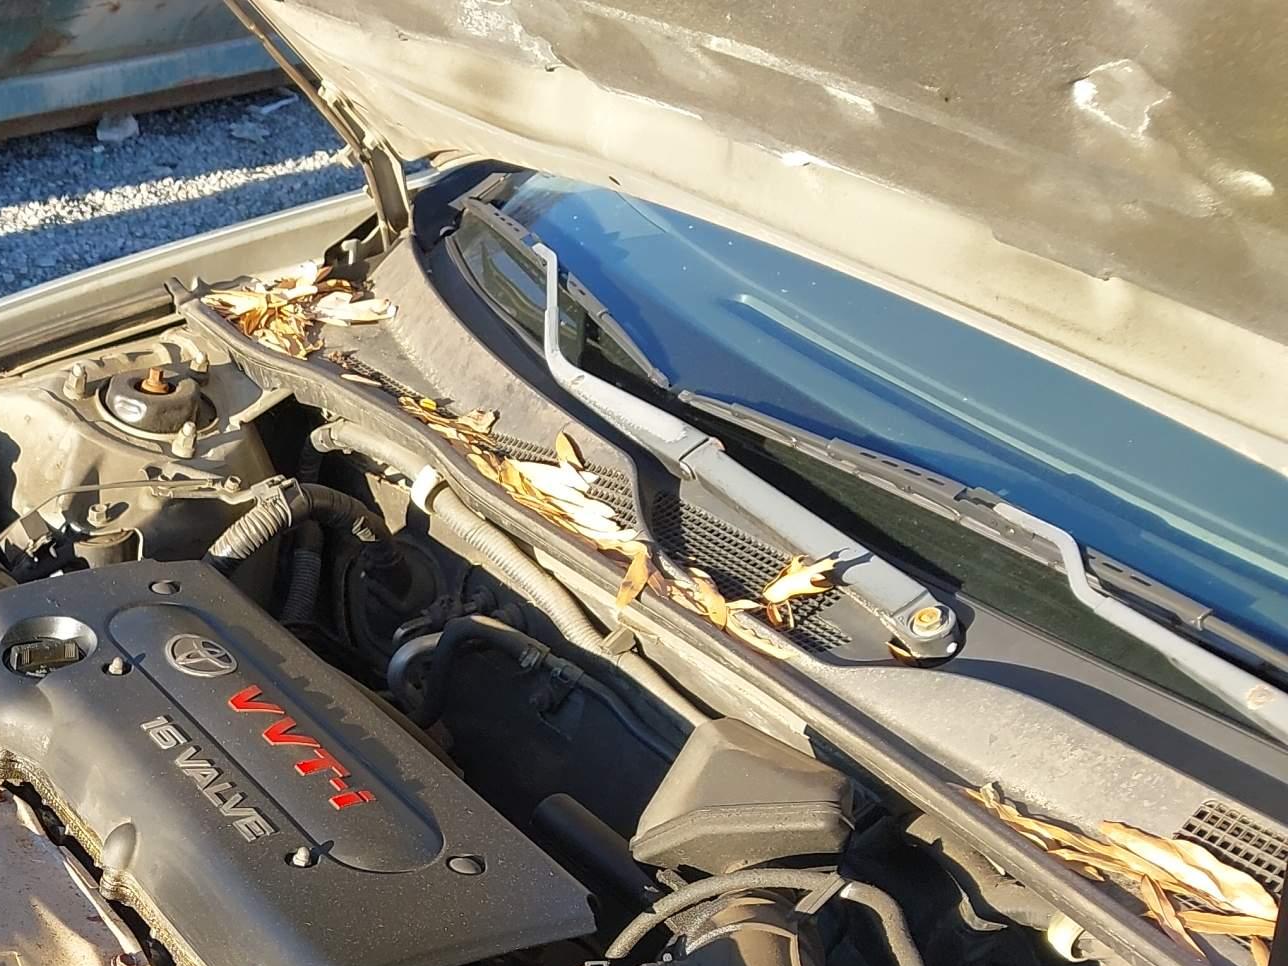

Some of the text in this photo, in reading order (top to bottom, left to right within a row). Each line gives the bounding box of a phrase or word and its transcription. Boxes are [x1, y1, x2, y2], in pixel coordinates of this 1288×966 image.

[140, 715, 277, 842] 16 VALVE
[228, 684, 377, 810] VVT-i
